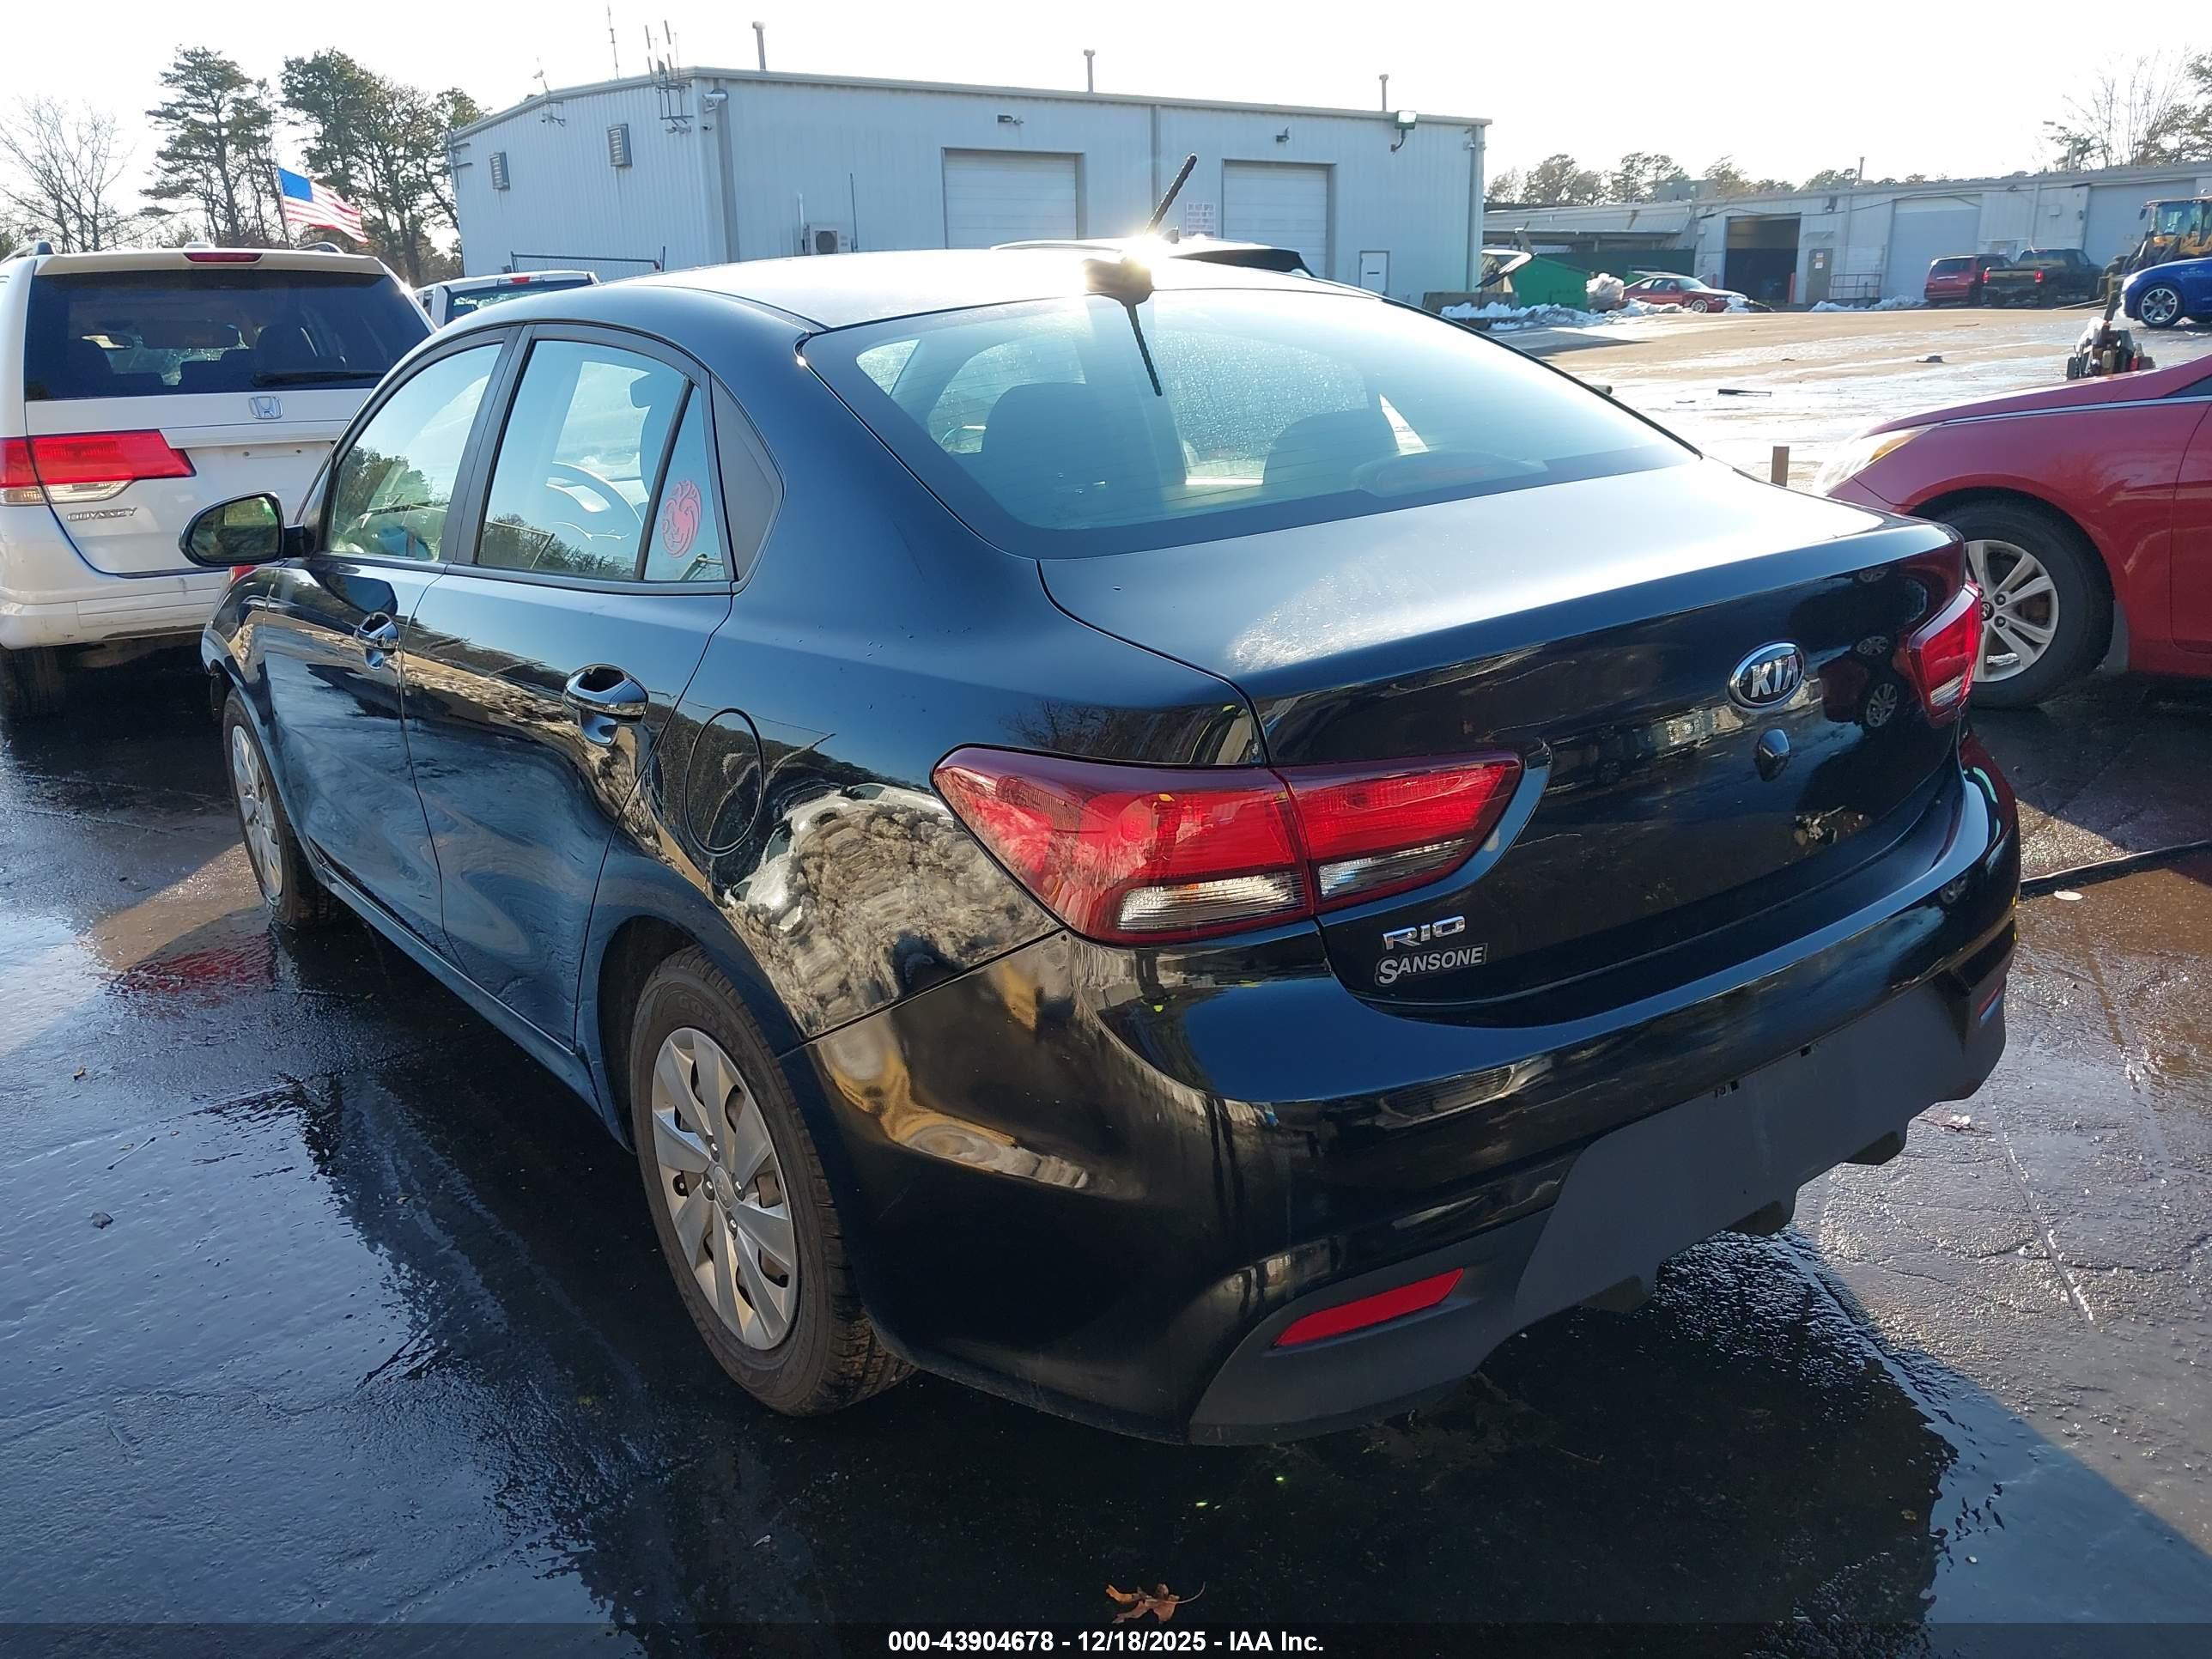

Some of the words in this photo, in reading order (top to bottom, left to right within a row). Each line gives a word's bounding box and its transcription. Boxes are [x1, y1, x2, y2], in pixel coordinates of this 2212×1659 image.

[66, 507, 137, 522] ODYSSEY
[1750, 654, 1799, 698] KIA
[1382, 915, 1466, 951] RIO
[1378, 946, 1484, 984] SANSONE
